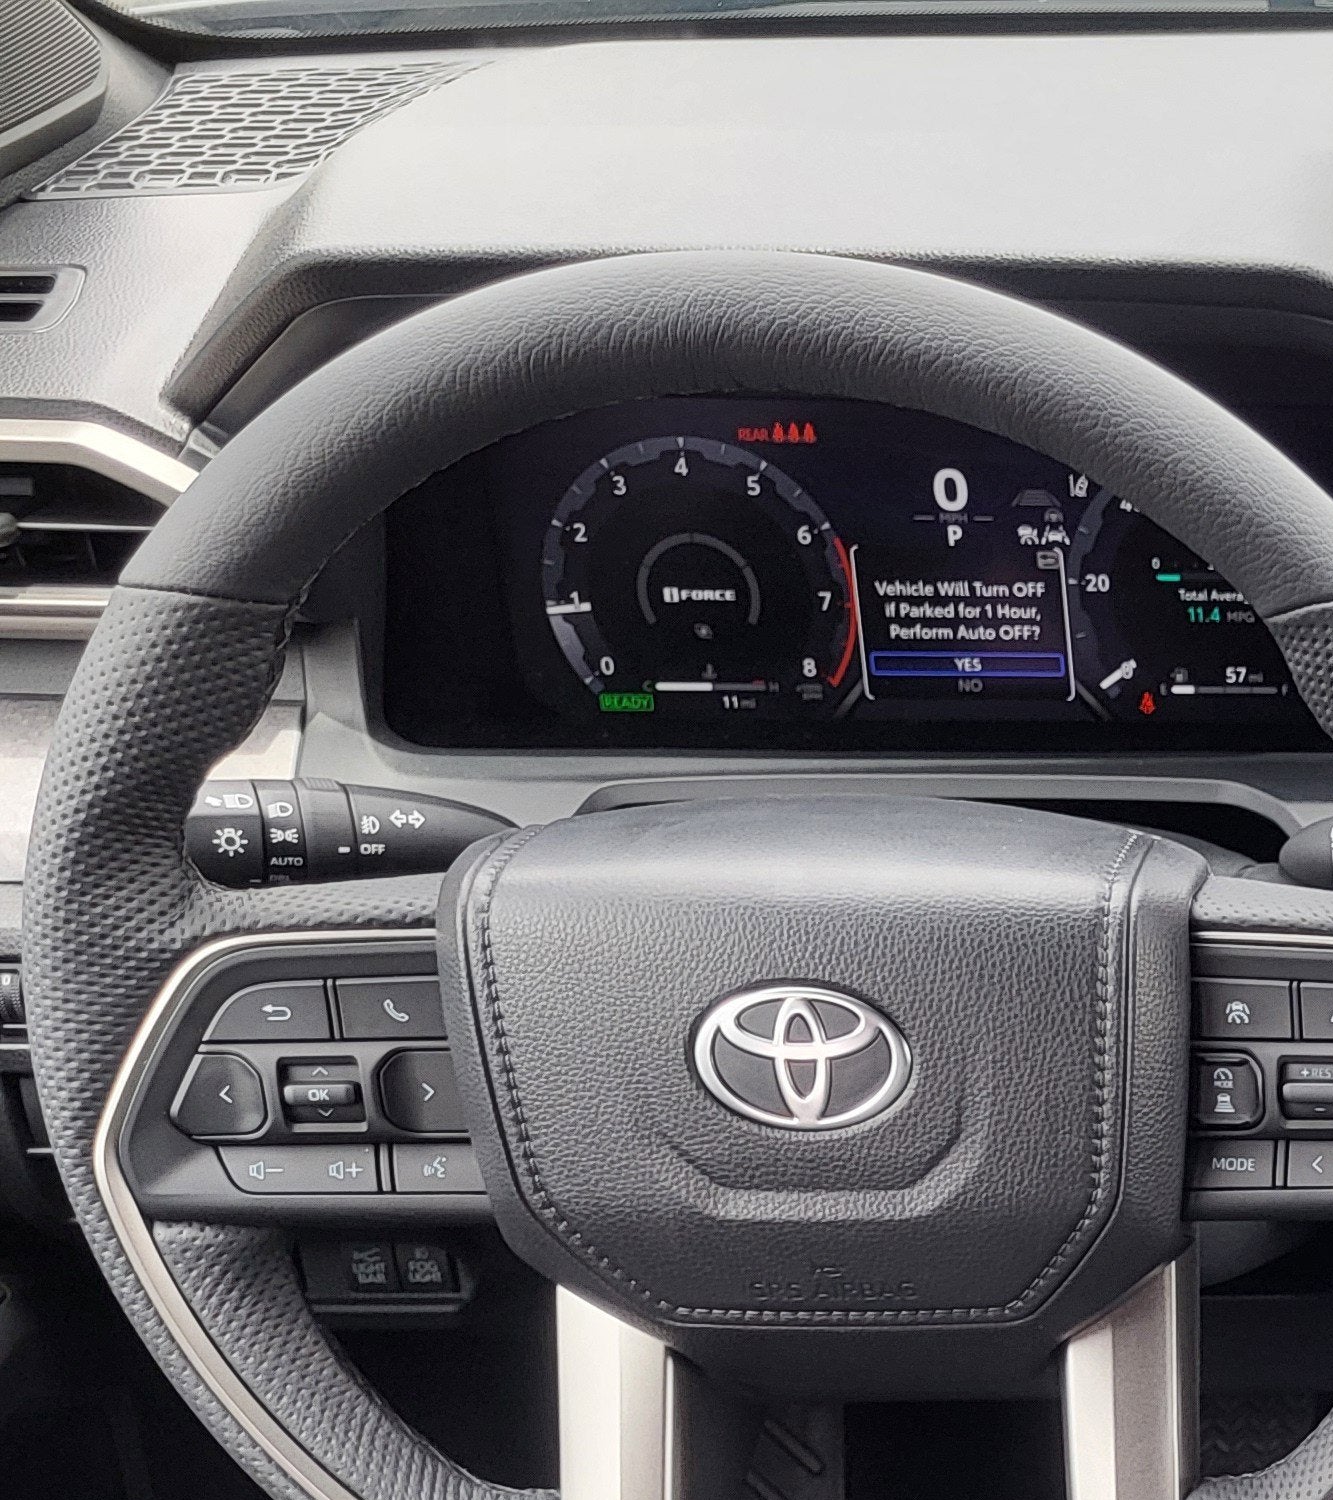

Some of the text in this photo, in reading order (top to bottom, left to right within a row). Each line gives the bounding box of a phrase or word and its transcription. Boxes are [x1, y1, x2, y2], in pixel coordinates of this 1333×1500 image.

[738, 428, 769, 442] REAR
[674, 458, 688, 476] 4
[613, 476, 627, 495] 3
[747, 476, 761, 496] 5
[934, 468, 968, 511] 0
[574, 523, 588, 542] 2
[797, 525, 812, 545] 6
[947, 525, 963, 546] P
[874, 580, 1046, 598] Vehicle Will Turn OFF
[1085, 574, 1110, 591] 20
[818, 591, 832, 611] 7
[1211, 589, 1250, 604] Avera
[884, 602, 1042, 621] If Parked for 1 Hour,
[1187, 606, 1221, 623] 11.4
[889, 623, 1041, 641] Perform Auto OFF?
[600, 657, 614, 676] 0
[802, 658, 817, 677] 8
[953, 658, 982, 672] YES
[1225, 666, 1247, 684] 57
[957, 679, 983, 692] NO
[360, 844, 386, 855] OFF
[270, 857, 303, 866] AUTO
[307, 1089, 330, 1101] OK
[1212, 1158, 1256, 1172] MODE
